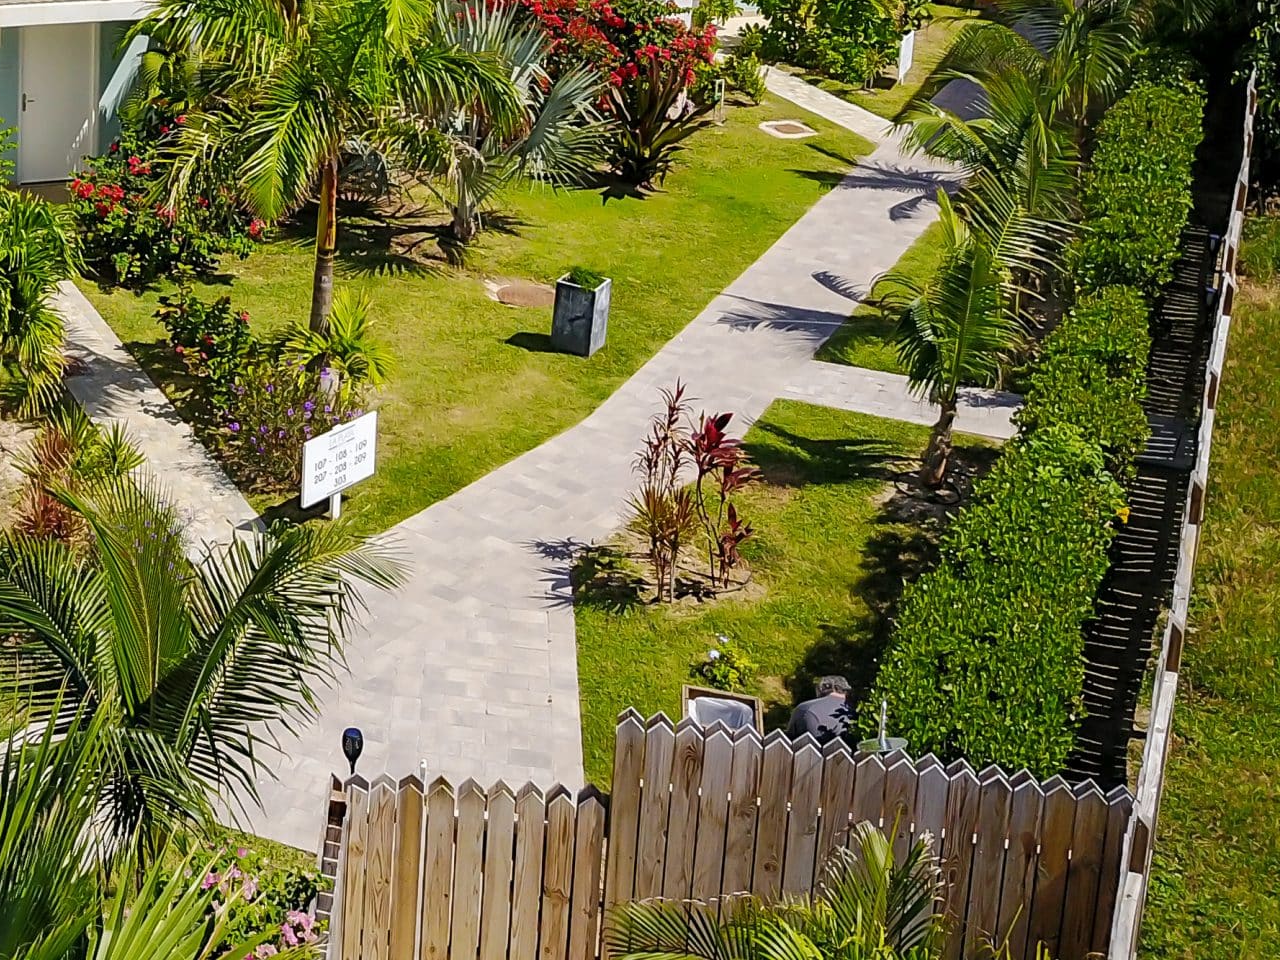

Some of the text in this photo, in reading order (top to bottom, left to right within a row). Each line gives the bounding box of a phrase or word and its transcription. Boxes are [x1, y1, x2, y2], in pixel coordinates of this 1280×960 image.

[314, 458, 327, 471] 107
[355, 439, 367, 452] 109
[314, 471, 327, 484] 207
[354, 452, 367, 465] 209
